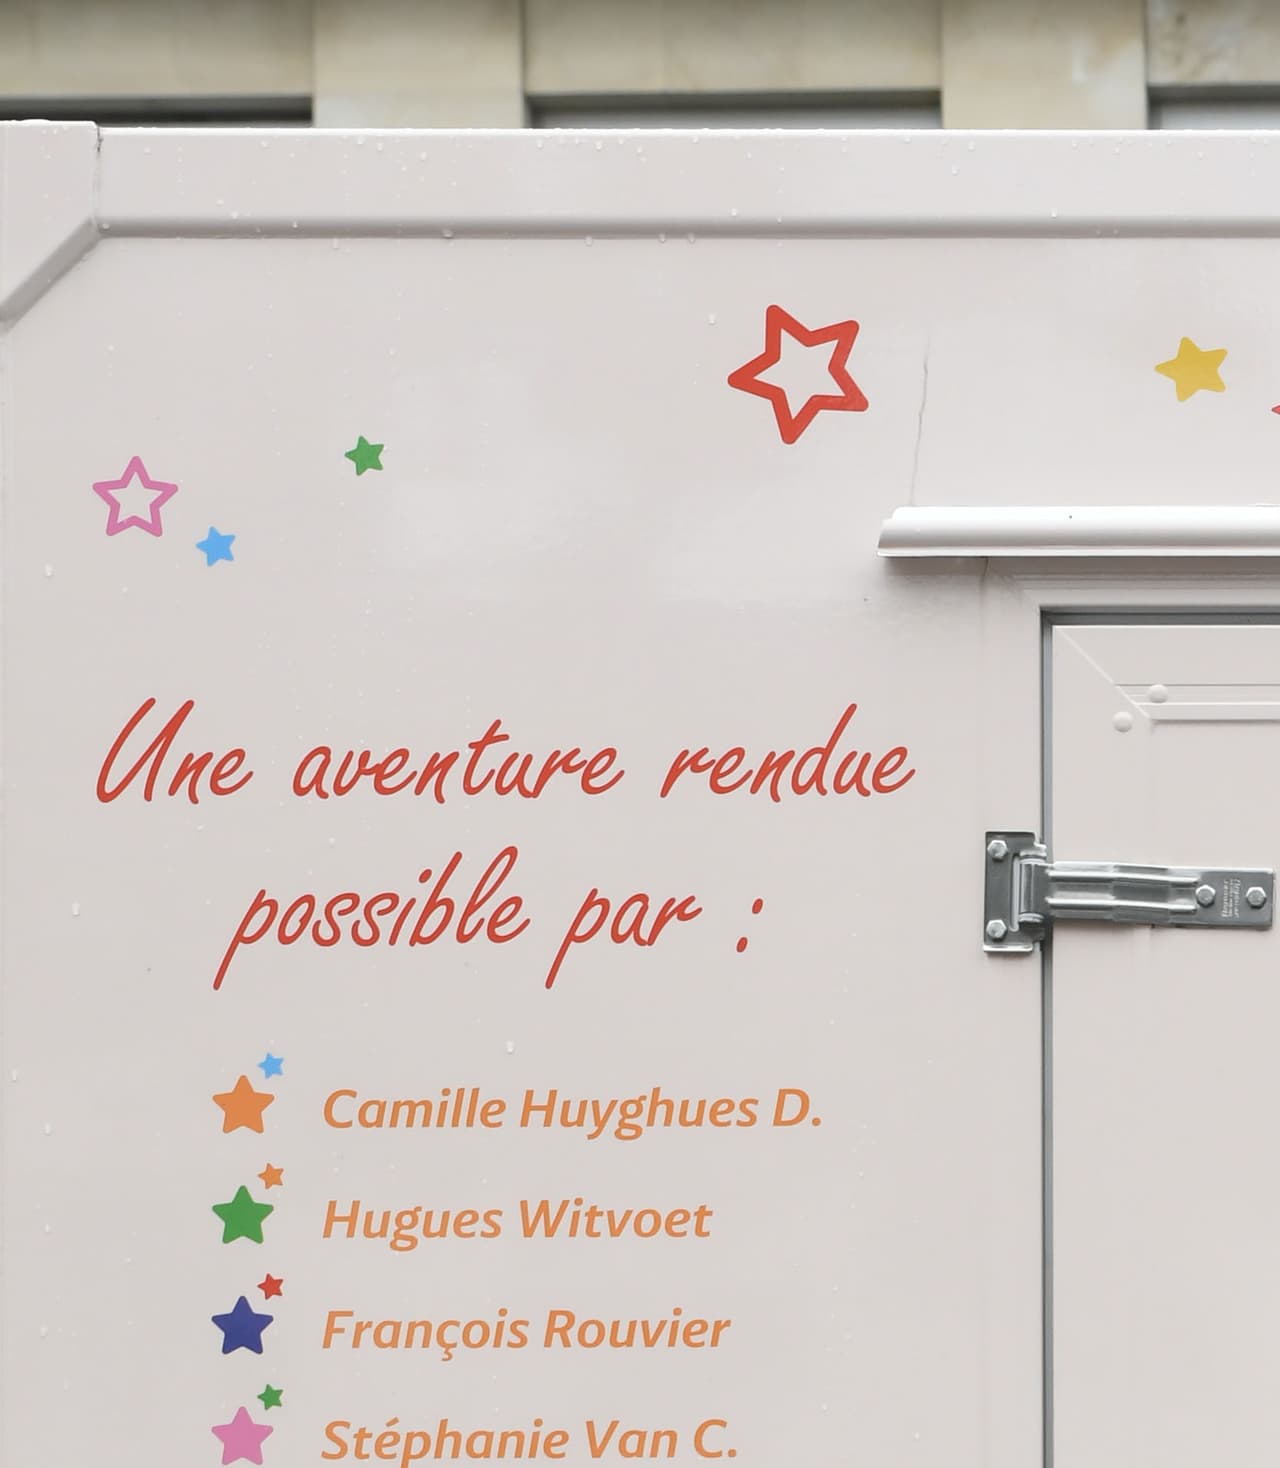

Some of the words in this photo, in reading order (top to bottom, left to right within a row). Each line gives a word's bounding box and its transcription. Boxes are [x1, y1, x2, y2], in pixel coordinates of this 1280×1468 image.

[95, 697, 254, 805] Une
[292, 719, 625, 805] aventure
[660, 703, 916, 804] rendue
[212, 846, 531, 991] possible
[545, 887, 704, 990] par
[323, 1088, 508, 1130] Camille
[521, 1087, 761, 1142] Huyghues
[772, 1088, 823, 1129] D.
[323, 1200, 503, 1253] Hugues
[520, 1197, 714, 1240] Witvoet
[323, 1308, 530, 1362] François
[544, 1307, 733, 1350] Rouvier
[586, 1419, 680, 1460] Van
[693, 1418, 738, 1460] C.
